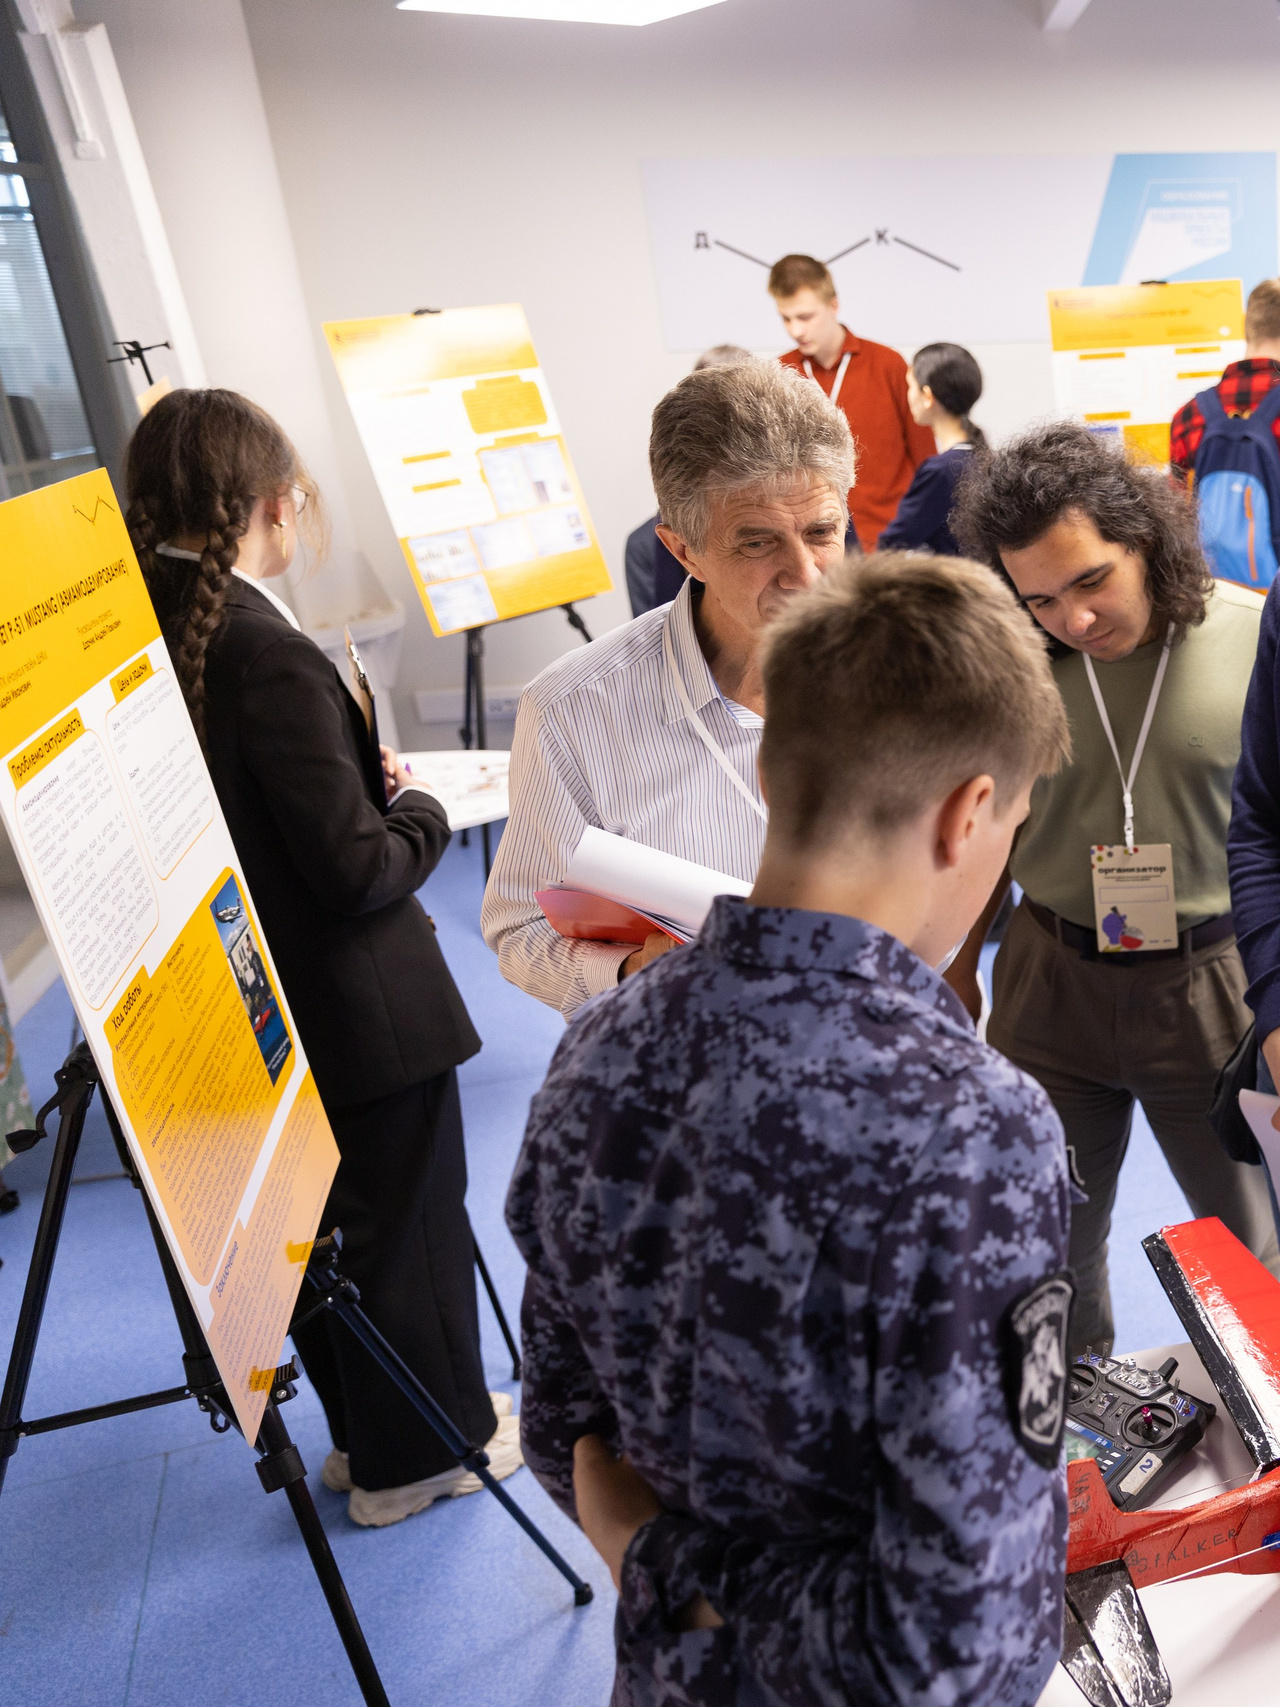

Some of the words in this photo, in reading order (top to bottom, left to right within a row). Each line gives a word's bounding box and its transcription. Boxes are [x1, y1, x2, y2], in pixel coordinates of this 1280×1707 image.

[695, 232, 710, 248] Д
[876, 229, 889, 244] К
[5, 615, 26, 639] P-51
[22, 596, 59, 630] MUSTANG
[54, 557, 130, 614] (АВИАМОДЕЛИРОВАНИЕ)
[115, 672, 130, 693] Цель
[131, 660, 149, 682] задачи
[10, 712, 82, 783] Проблема/актуальность
[1098, 866, 1166, 875] организатор
[110, 1006, 125, 1033] Ход
[120, 979, 143, 1017] работы
[215, 1236, 239, 1300] Заключение
[1116, 1373, 1149, 1390] FLYSKY
[1139, 1458, 1153, 1473] 2
